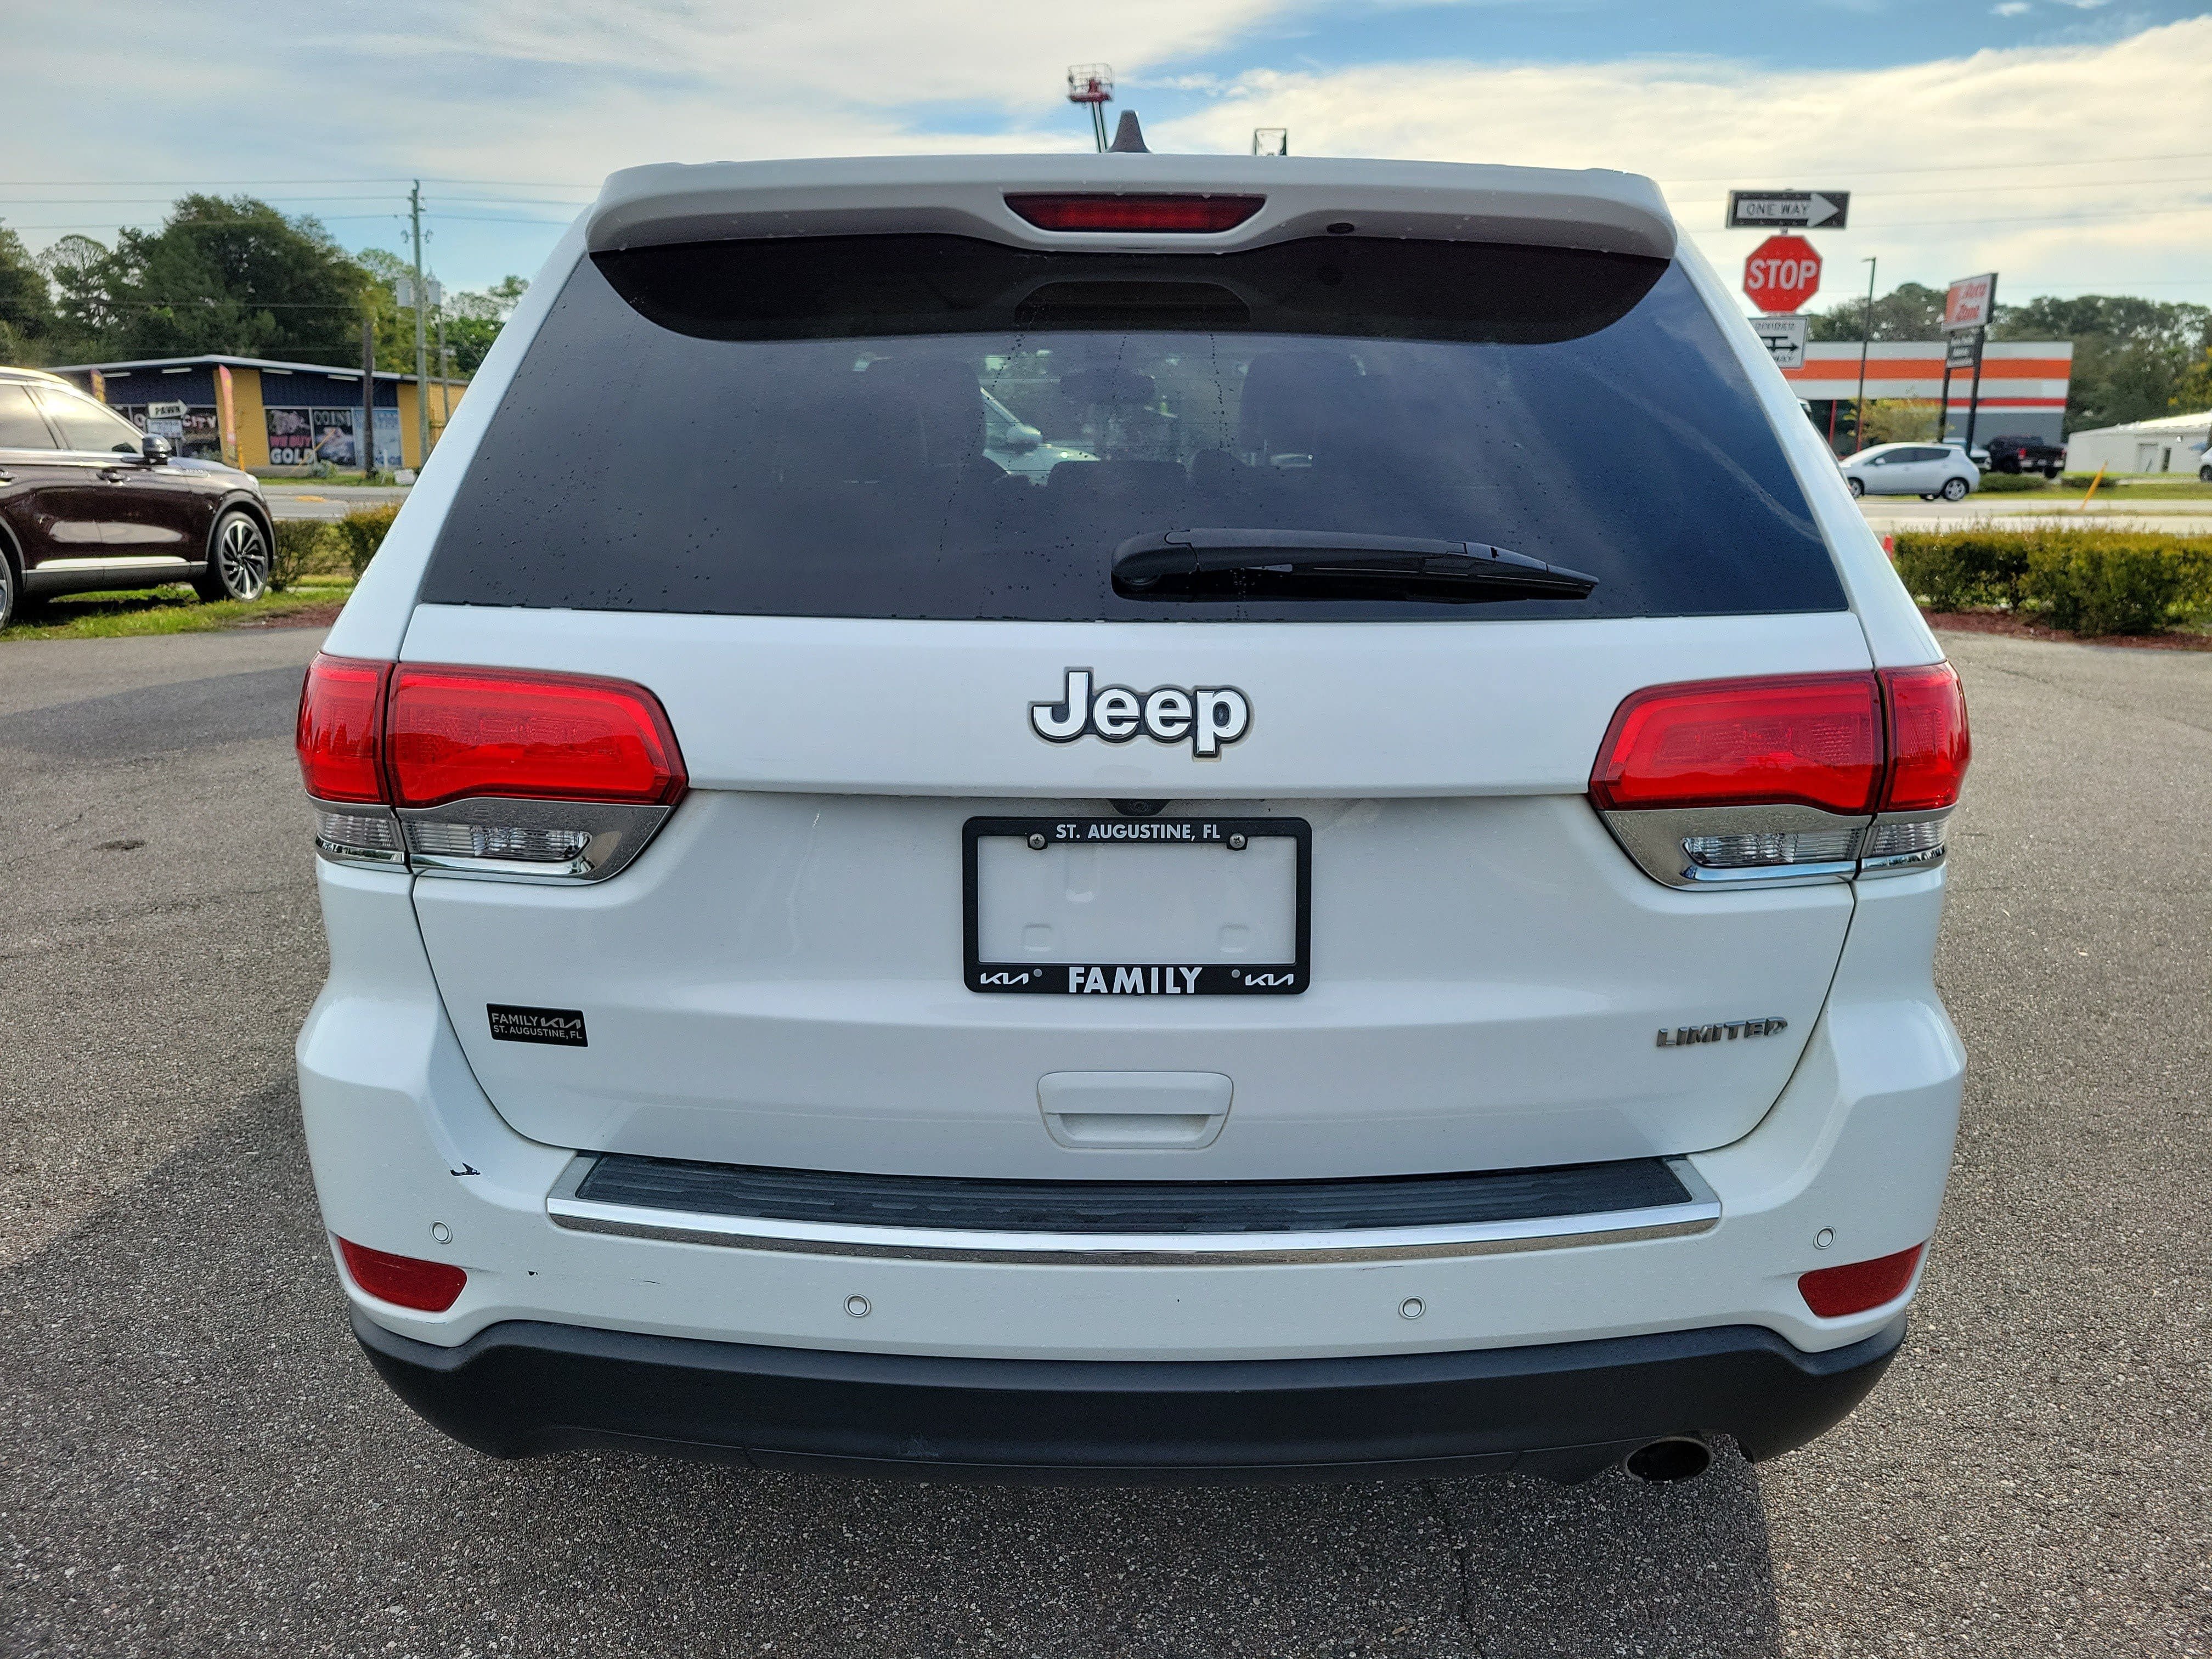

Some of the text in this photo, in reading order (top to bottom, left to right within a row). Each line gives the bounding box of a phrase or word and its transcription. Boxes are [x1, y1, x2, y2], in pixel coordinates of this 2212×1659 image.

[1747, 203, 1809, 216] ONE WAY
[1747, 258, 1818, 290] STOP
[155, 406, 180, 415] PAWN
[182, 414, 217, 429] CITY
[270, 436, 312, 447] WE BUY
[270, 447, 314, 464] GOLD
[1032, 670, 1249, 758] Jeep
[1056, 824, 1221, 842] ST. AUGUSTINE, FL
[1069, 967, 1203, 994] FAMILY
[492, 1013, 538, 1026] FAMILY
[493, 1024, 583, 1040] ST. AUGUSTINE, FL
[1656, 1015, 1787, 1047] LIMITED
